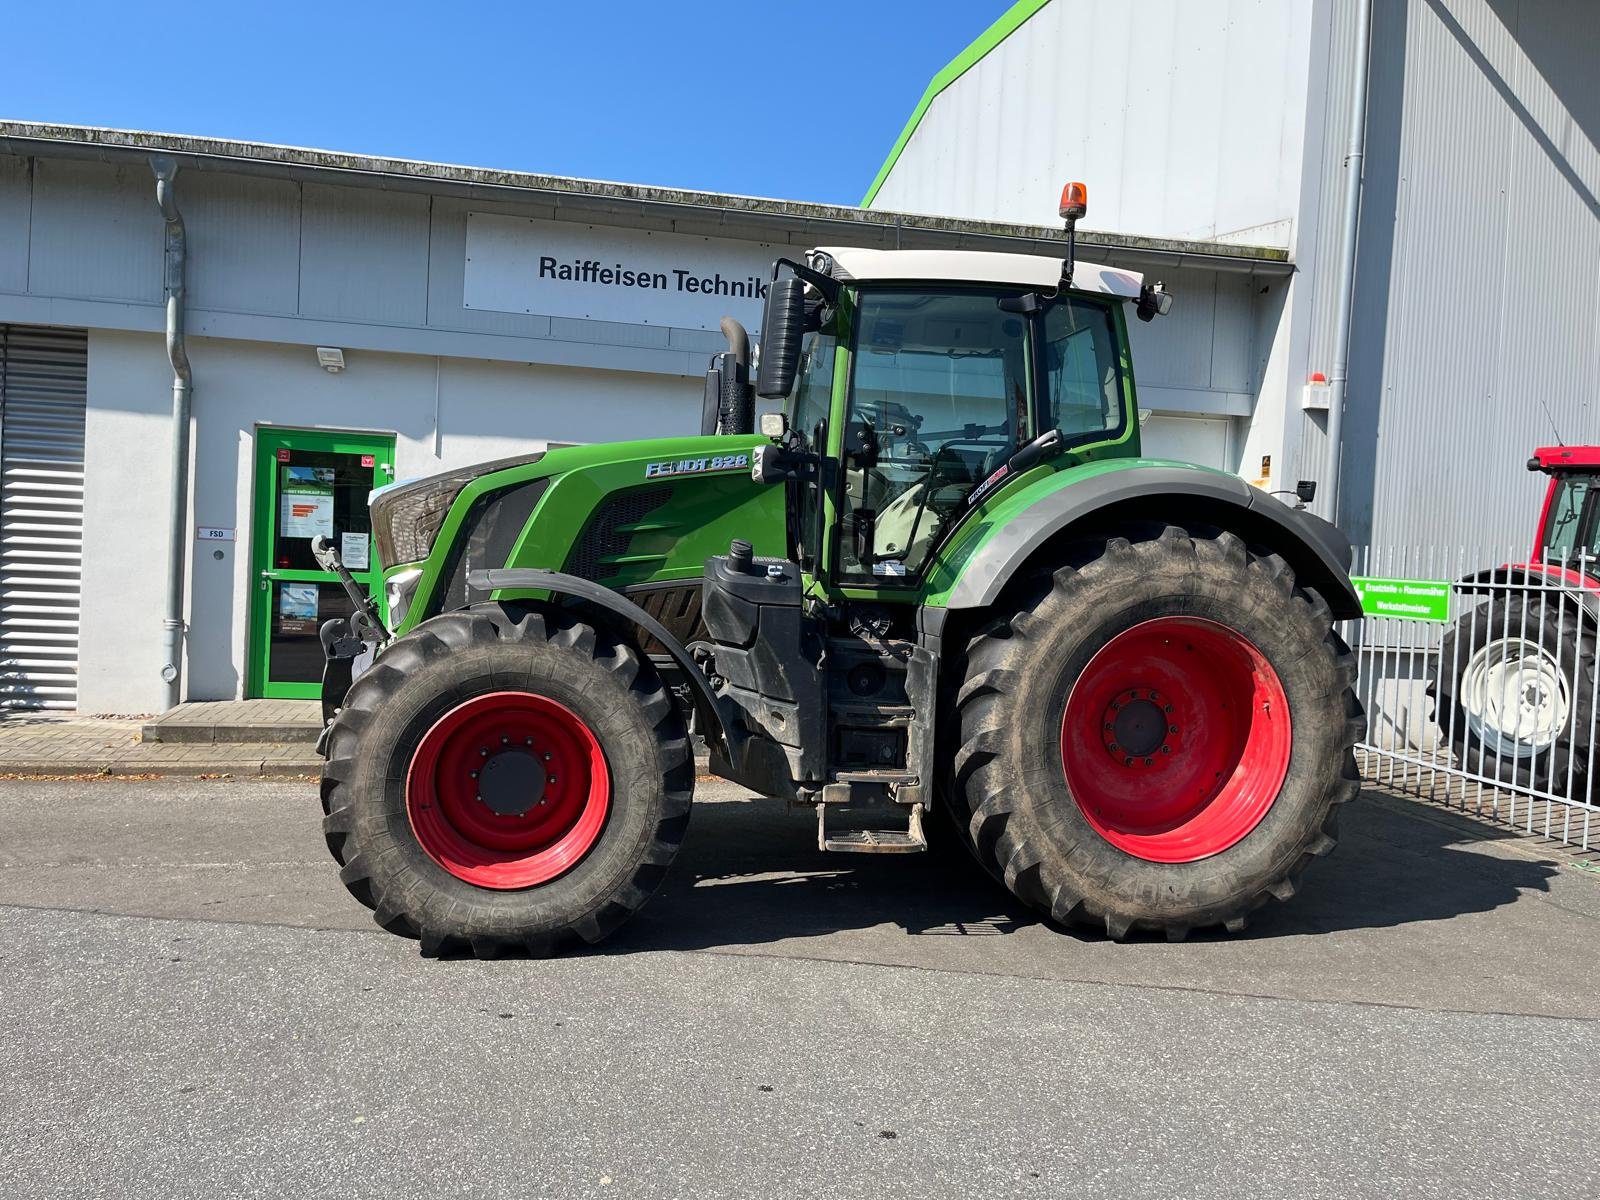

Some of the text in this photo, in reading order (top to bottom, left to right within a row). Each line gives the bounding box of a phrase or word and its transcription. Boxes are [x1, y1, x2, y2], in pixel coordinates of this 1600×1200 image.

[539, 256, 768, 299] Raiffeisen Technik
[646, 454, 748, 478] FENDT 828
[209, 530, 224, 538] FSD
